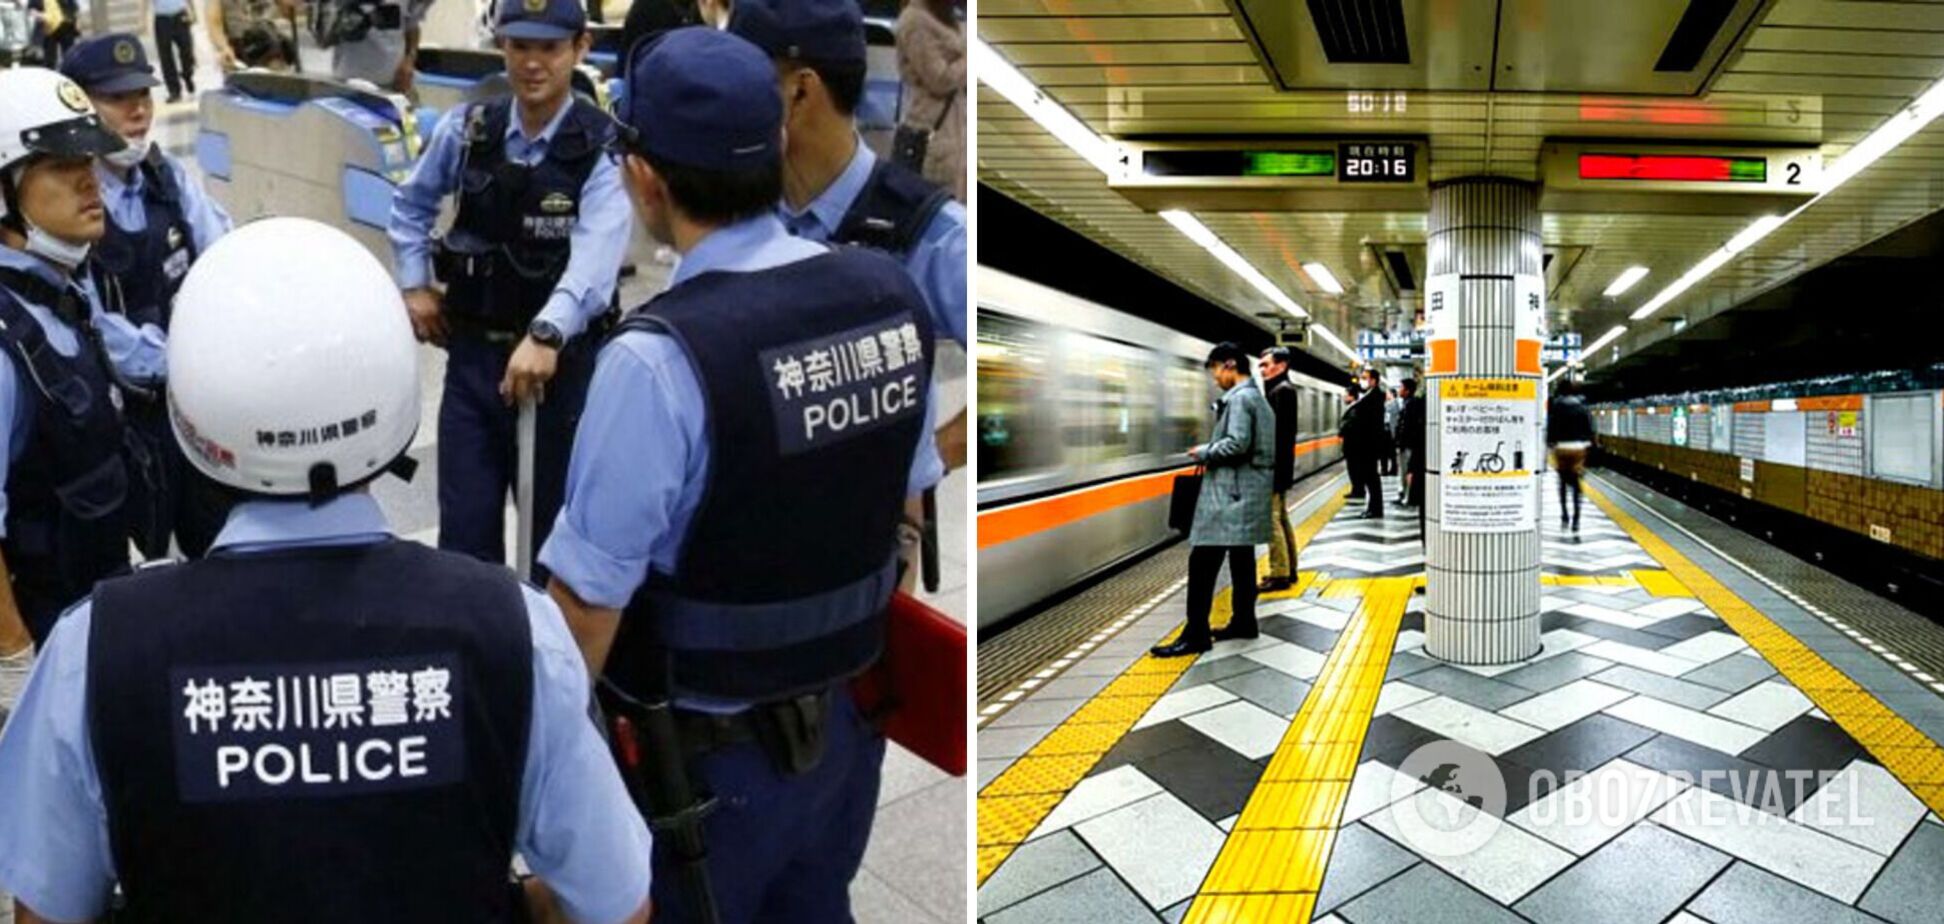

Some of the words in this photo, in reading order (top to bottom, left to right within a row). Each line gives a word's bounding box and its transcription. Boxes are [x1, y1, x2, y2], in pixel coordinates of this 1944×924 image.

[1346, 159, 1407, 176] 20:16
[1348, 145, 1405, 157] 現在時刻
[1786, 162, 1801, 185] 2
[773, 322, 923, 400] 神奈川県警察
[256, 409, 377, 447] 神奈川県警察
[803, 375, 916, 441] POLICE
[182, 666, 452, 734] 神奈川県警察
[216, 735, 428, 788] POLICE
